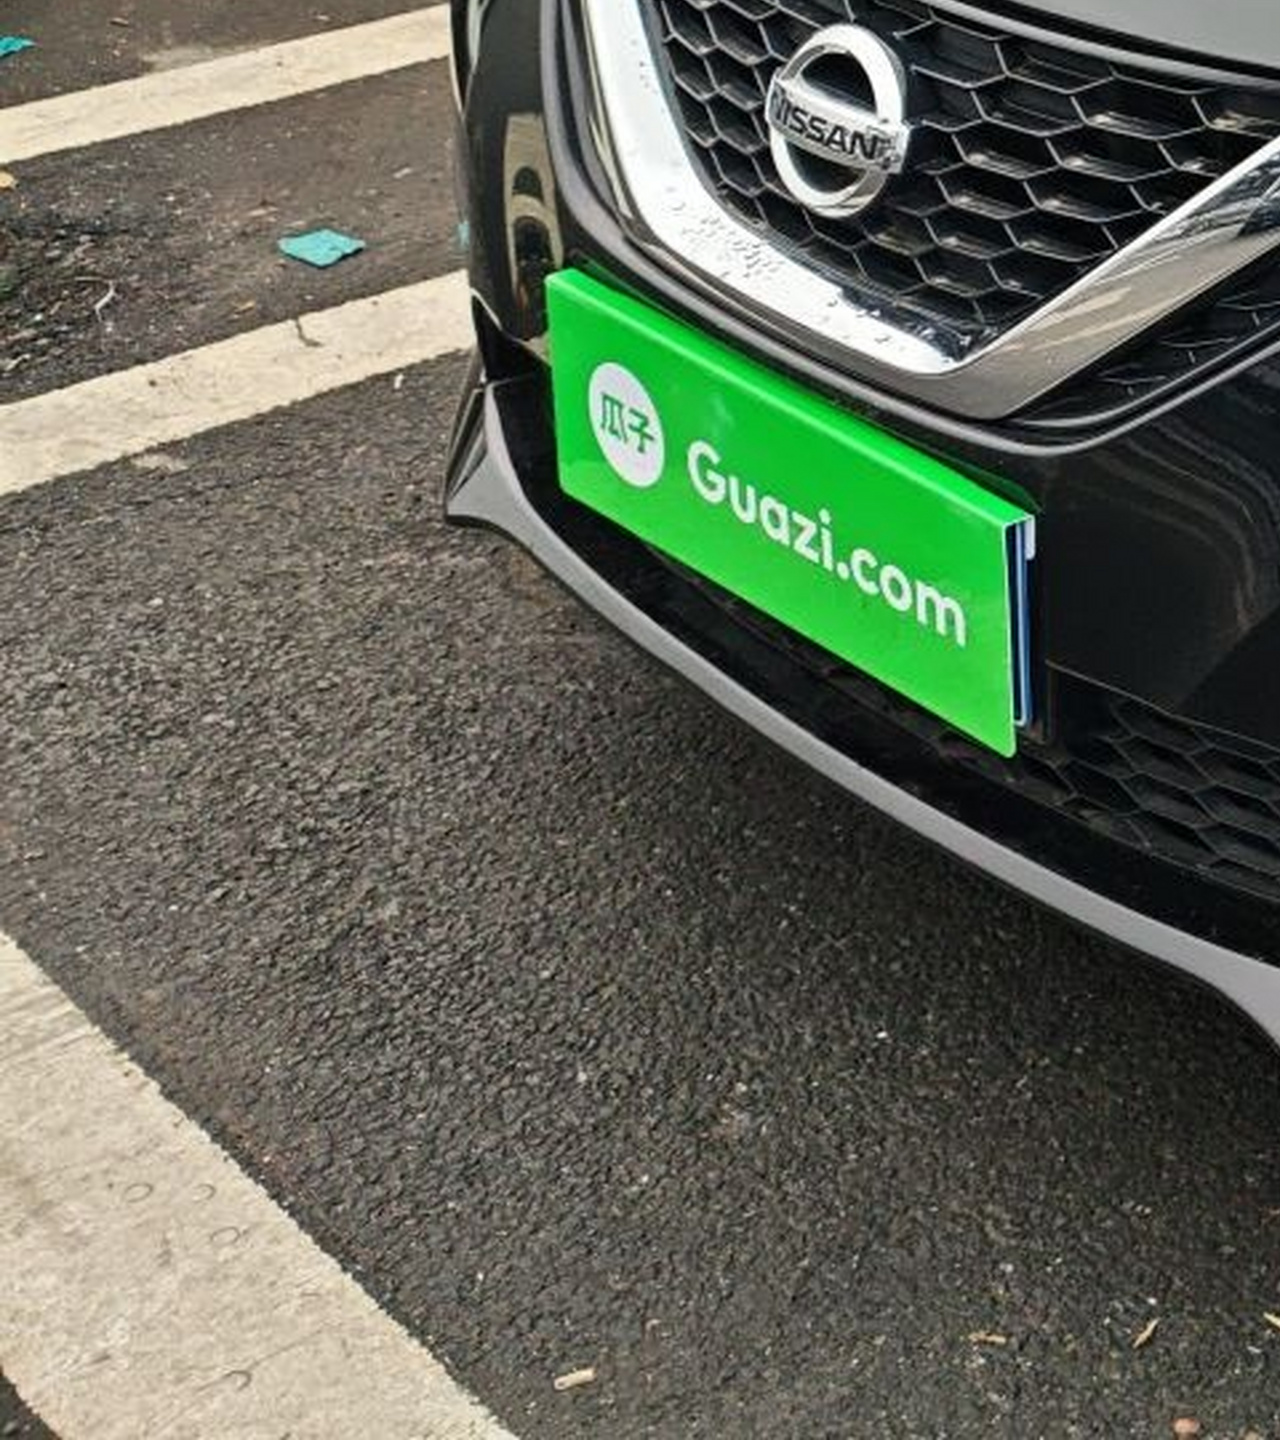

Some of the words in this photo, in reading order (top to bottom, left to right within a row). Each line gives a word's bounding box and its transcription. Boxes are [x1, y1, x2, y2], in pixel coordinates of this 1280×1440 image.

[771, 84, 884, 161] NISSAN
[600, 391, 655, 454] 瓜子
[686, 440, 968, 647] Guazi.com
